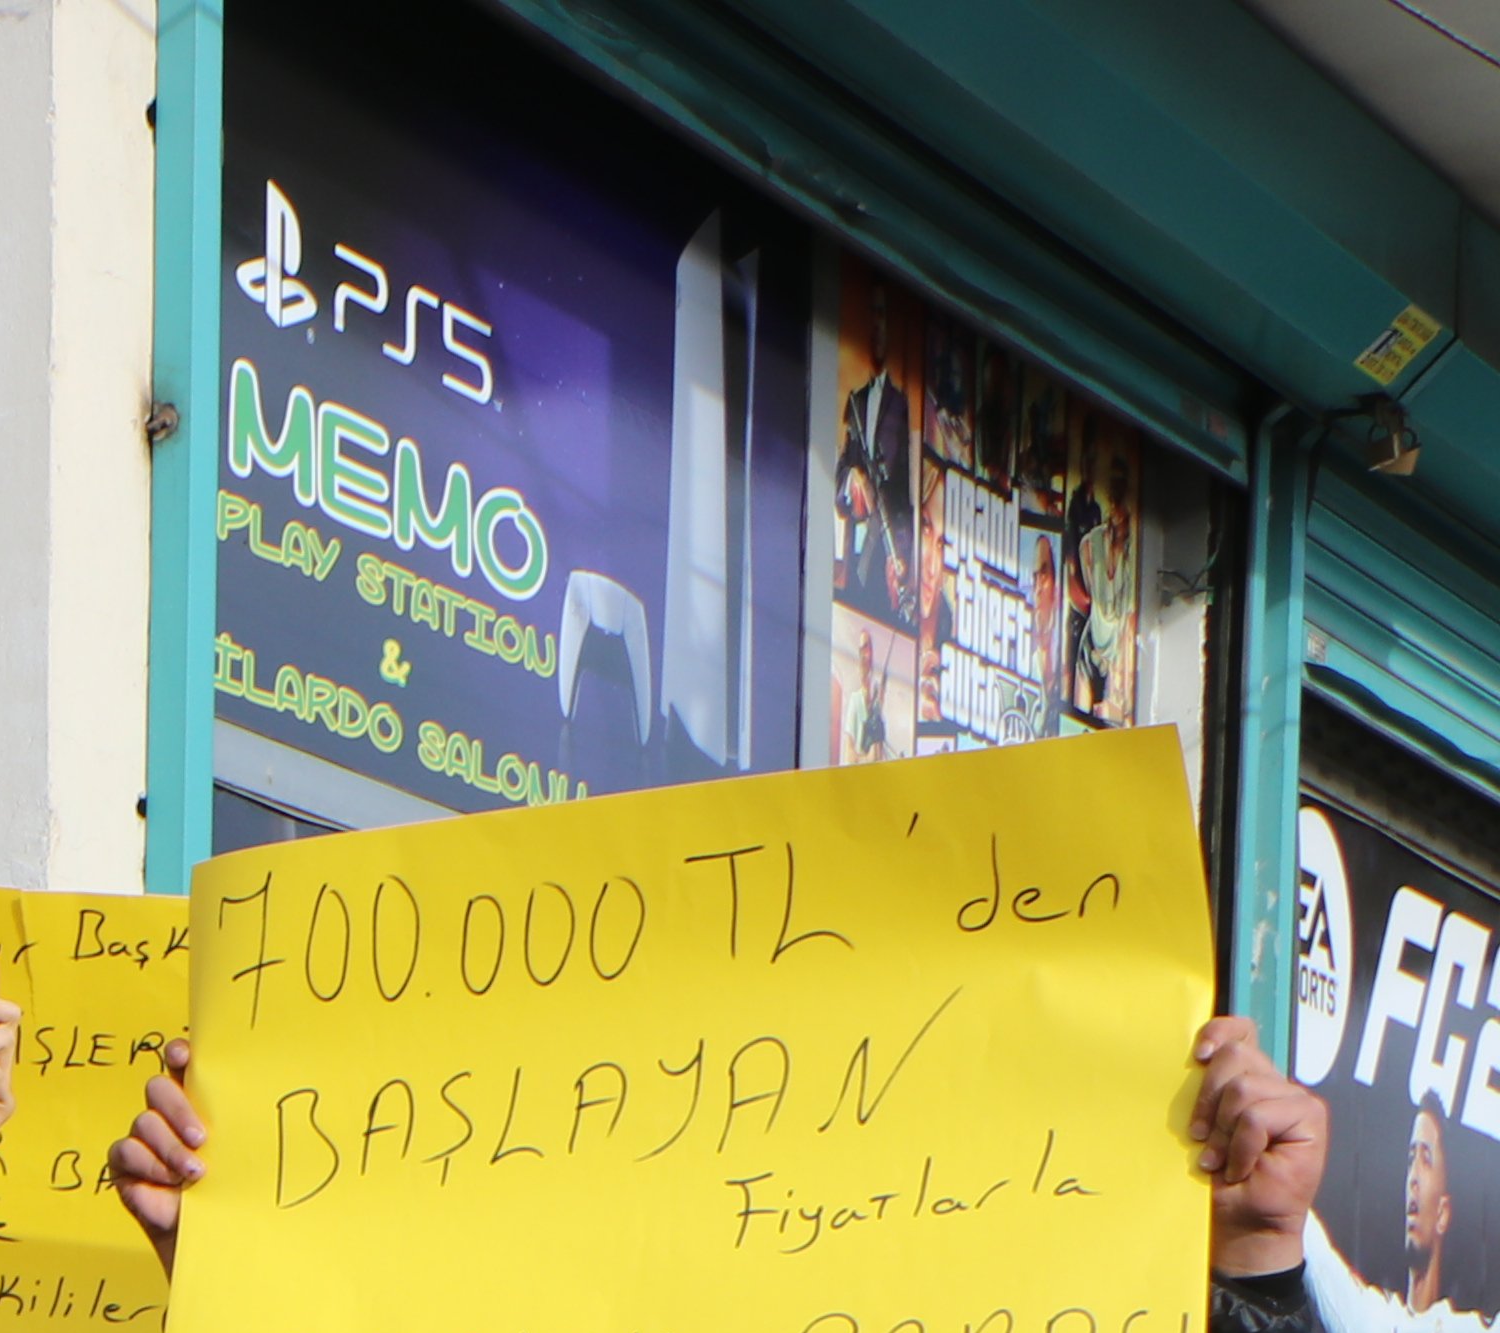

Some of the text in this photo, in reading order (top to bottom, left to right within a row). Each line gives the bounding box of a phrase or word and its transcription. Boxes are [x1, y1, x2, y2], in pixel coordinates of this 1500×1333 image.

[333, 242, 493, 405] PS5
[227, 356, 548, 601] MEMO
[216, 488, 557, 679] PLAY STATION
[378, 637, 412, 688] &
[213, 631, 404, 754] İLARDO
[216, 869, 648, 1030] 700.000
[1298, 962, 1337, 1018] ORTS
[274, 985, 963, 1211] BAŞLAYAN
